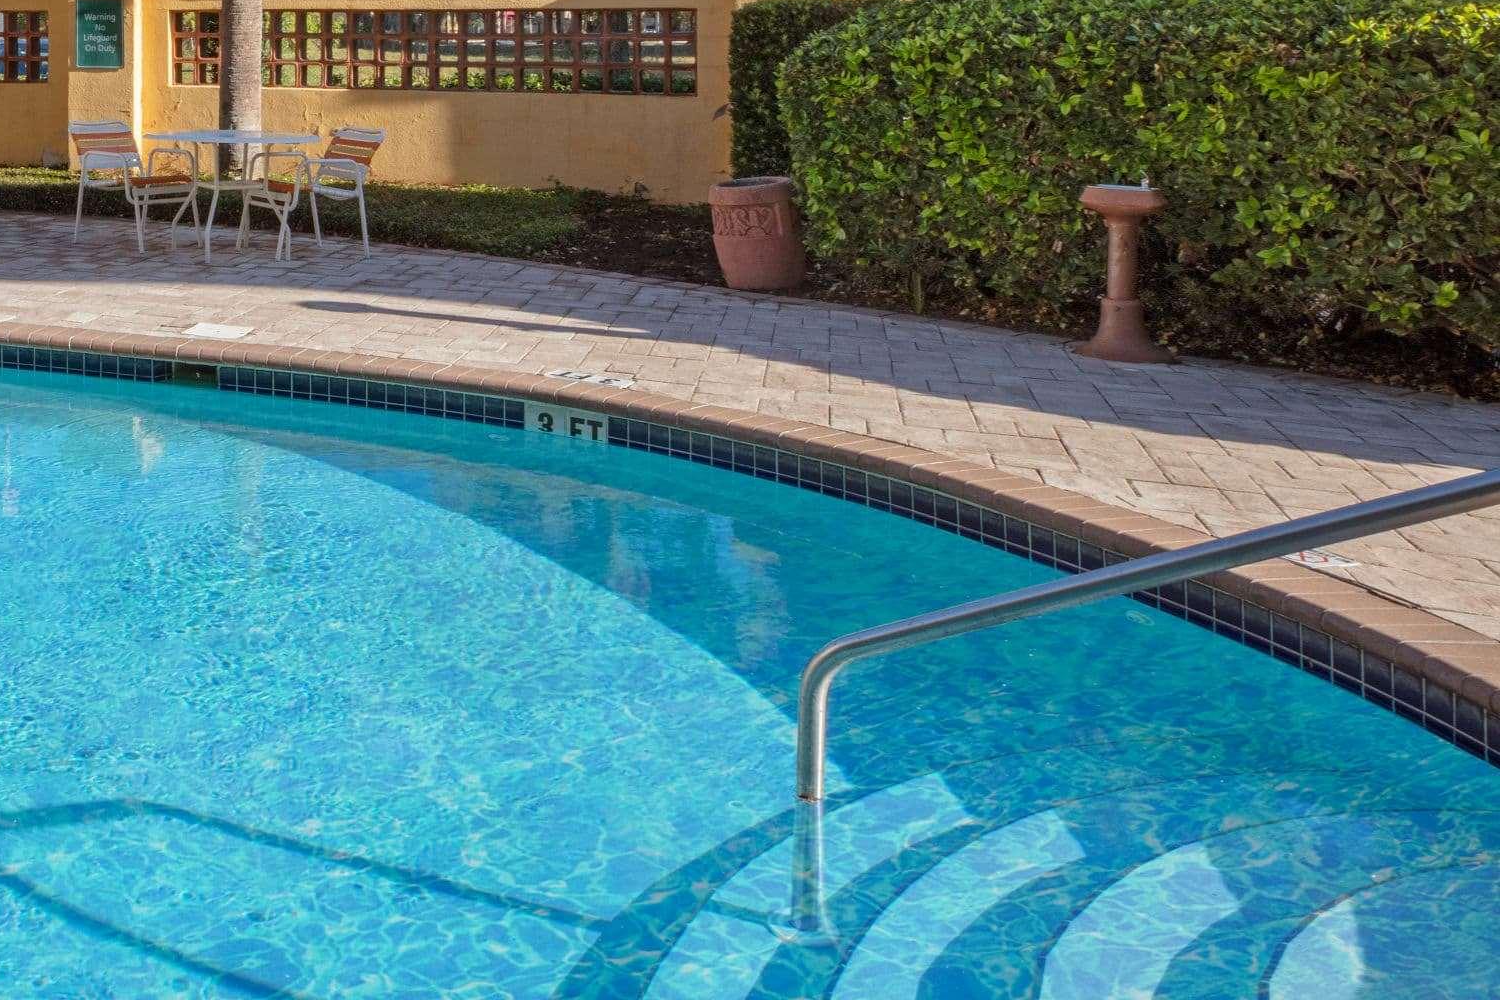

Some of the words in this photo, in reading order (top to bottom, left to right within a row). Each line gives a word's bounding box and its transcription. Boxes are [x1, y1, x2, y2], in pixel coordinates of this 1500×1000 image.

[84, 13, 116, 23] Warning
[83, 34, 117, 44] Lifeguard
[84, 44, 97, 52] On
[97, 45, 116, 54] Duty
[537, 412, 554, 433] 3
[569, 416, 604, 441] FT
